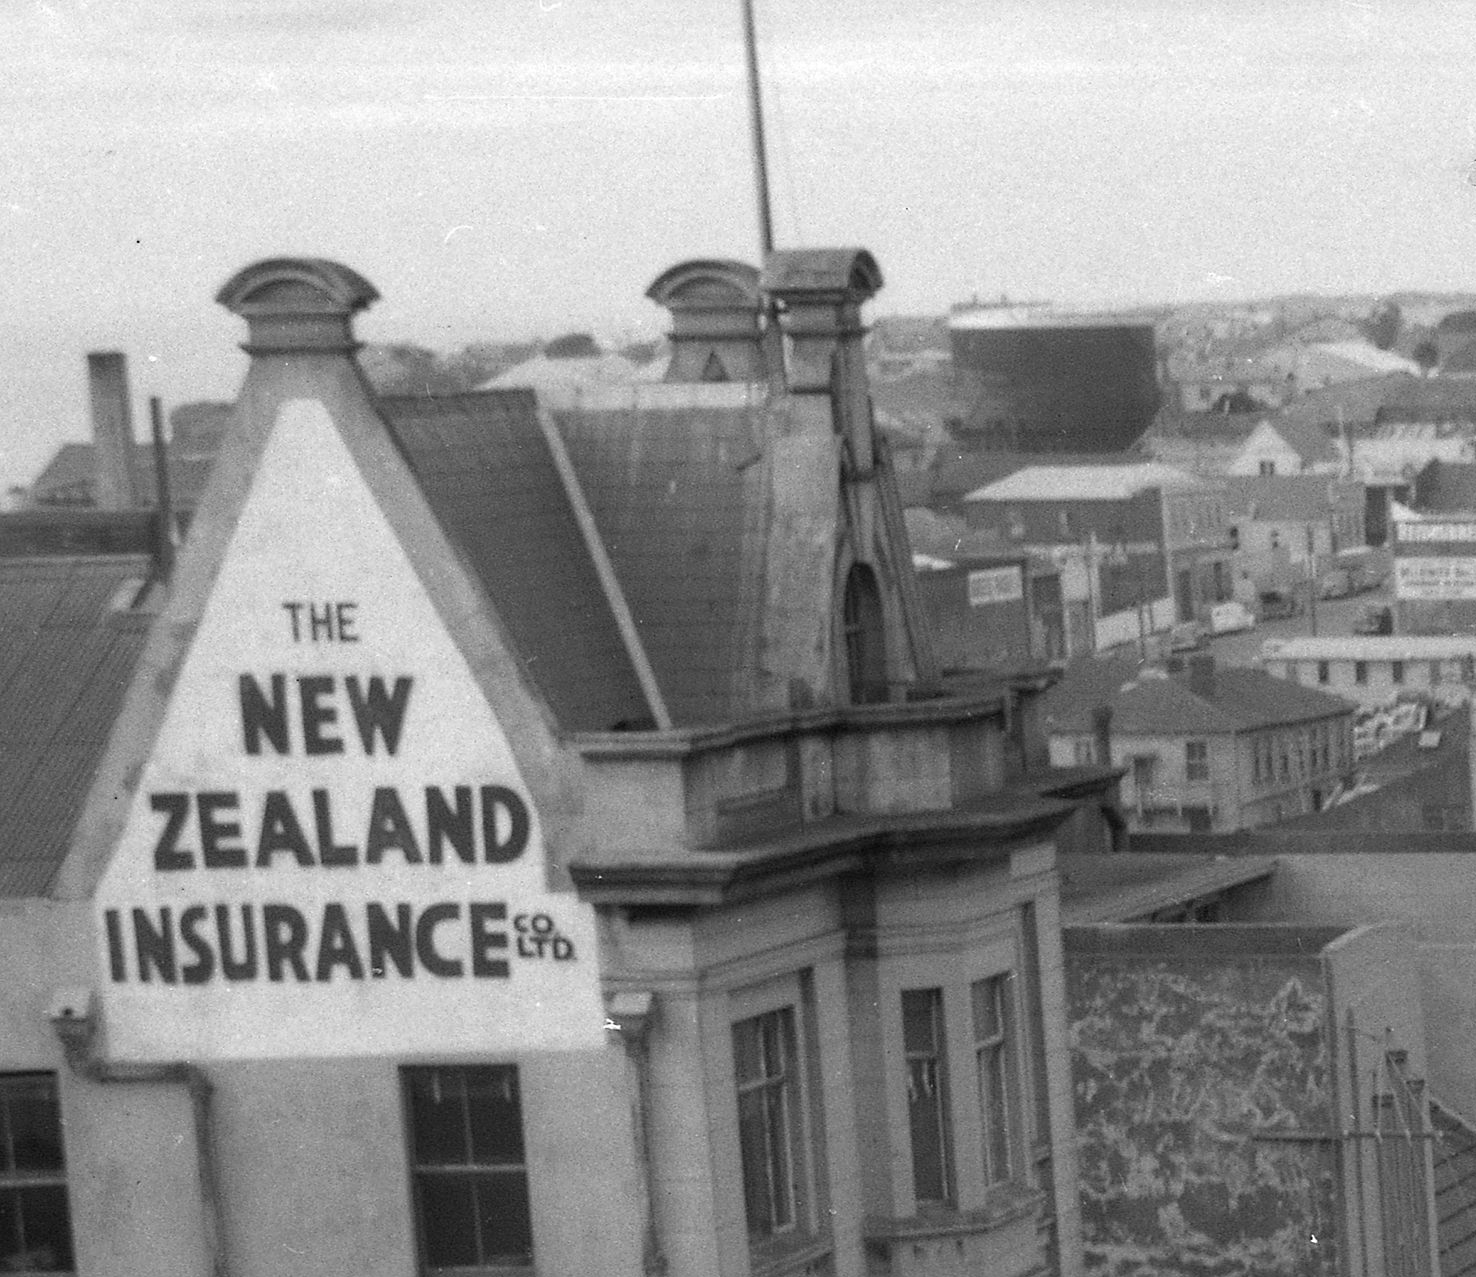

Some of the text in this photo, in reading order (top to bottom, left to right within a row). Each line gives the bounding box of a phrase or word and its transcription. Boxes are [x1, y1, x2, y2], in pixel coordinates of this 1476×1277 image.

[283, 602, 361, 643] THE
[238, 673, 414, 757] NEW
[148, 785, 531, 872] ZEALAND
[103, 902, 512, 985] INSURANCE
